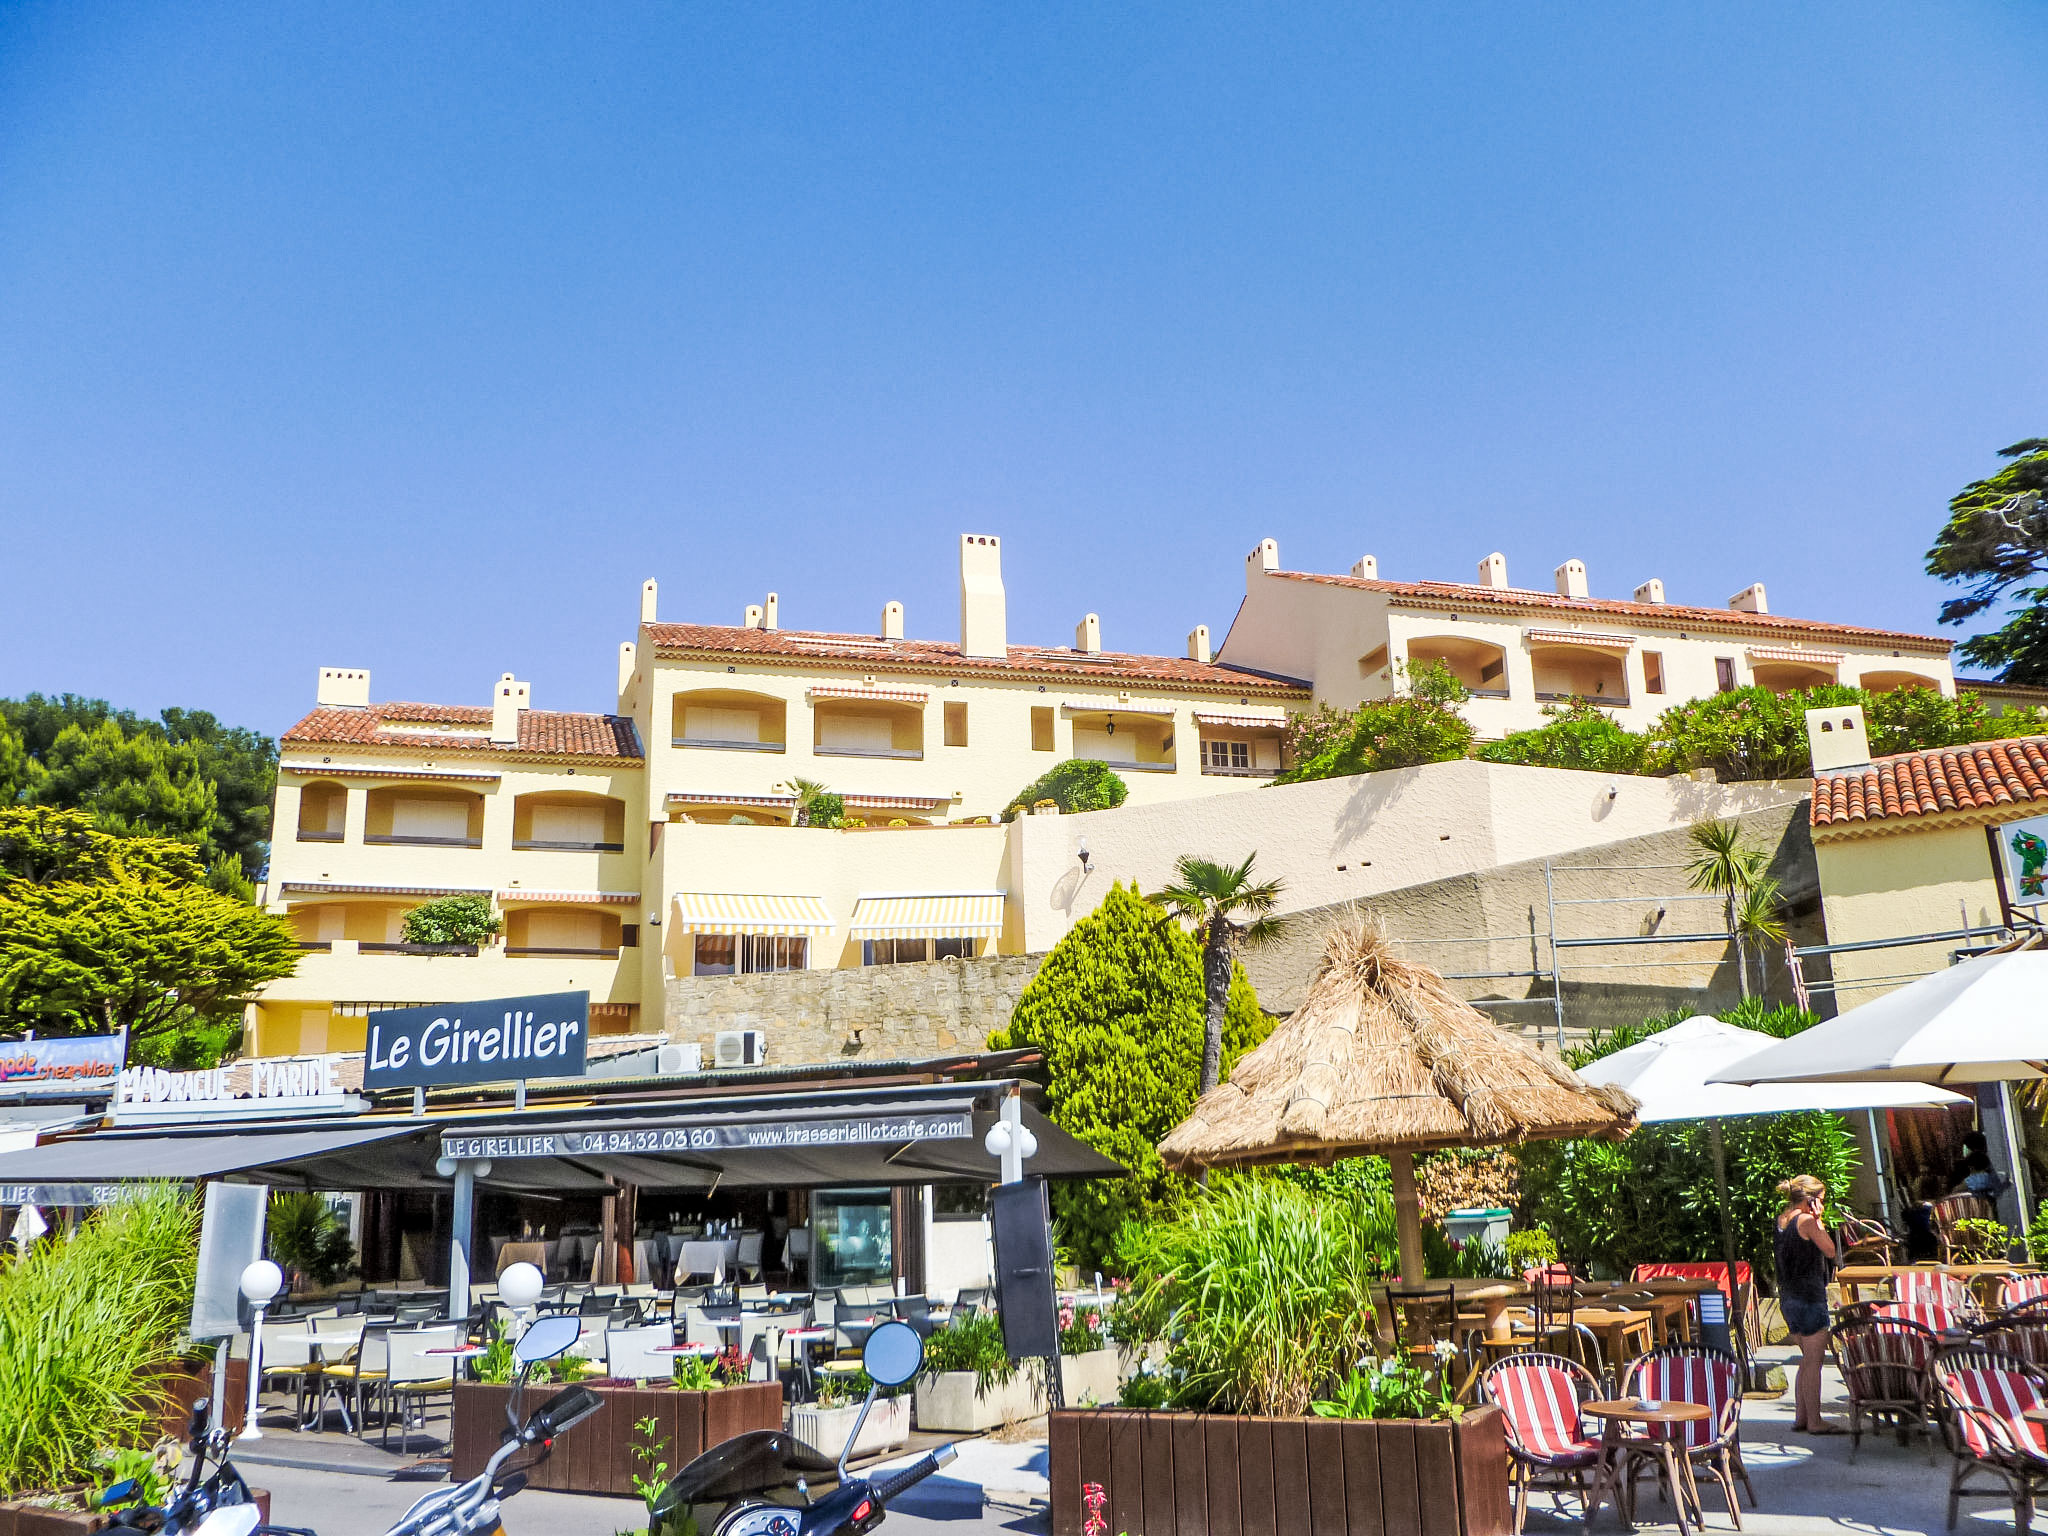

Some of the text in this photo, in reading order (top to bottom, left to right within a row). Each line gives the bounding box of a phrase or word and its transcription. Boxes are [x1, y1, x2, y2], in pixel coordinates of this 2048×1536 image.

[369, 1010, 579, 1070] Le Girellier
[117, 1056, 345, 1103] MADRAGUE MARINE
[446, 1119, 963, 1157] LE GIRELLIER 04.94.32.03.60 www.brasserielilotcafe.com
